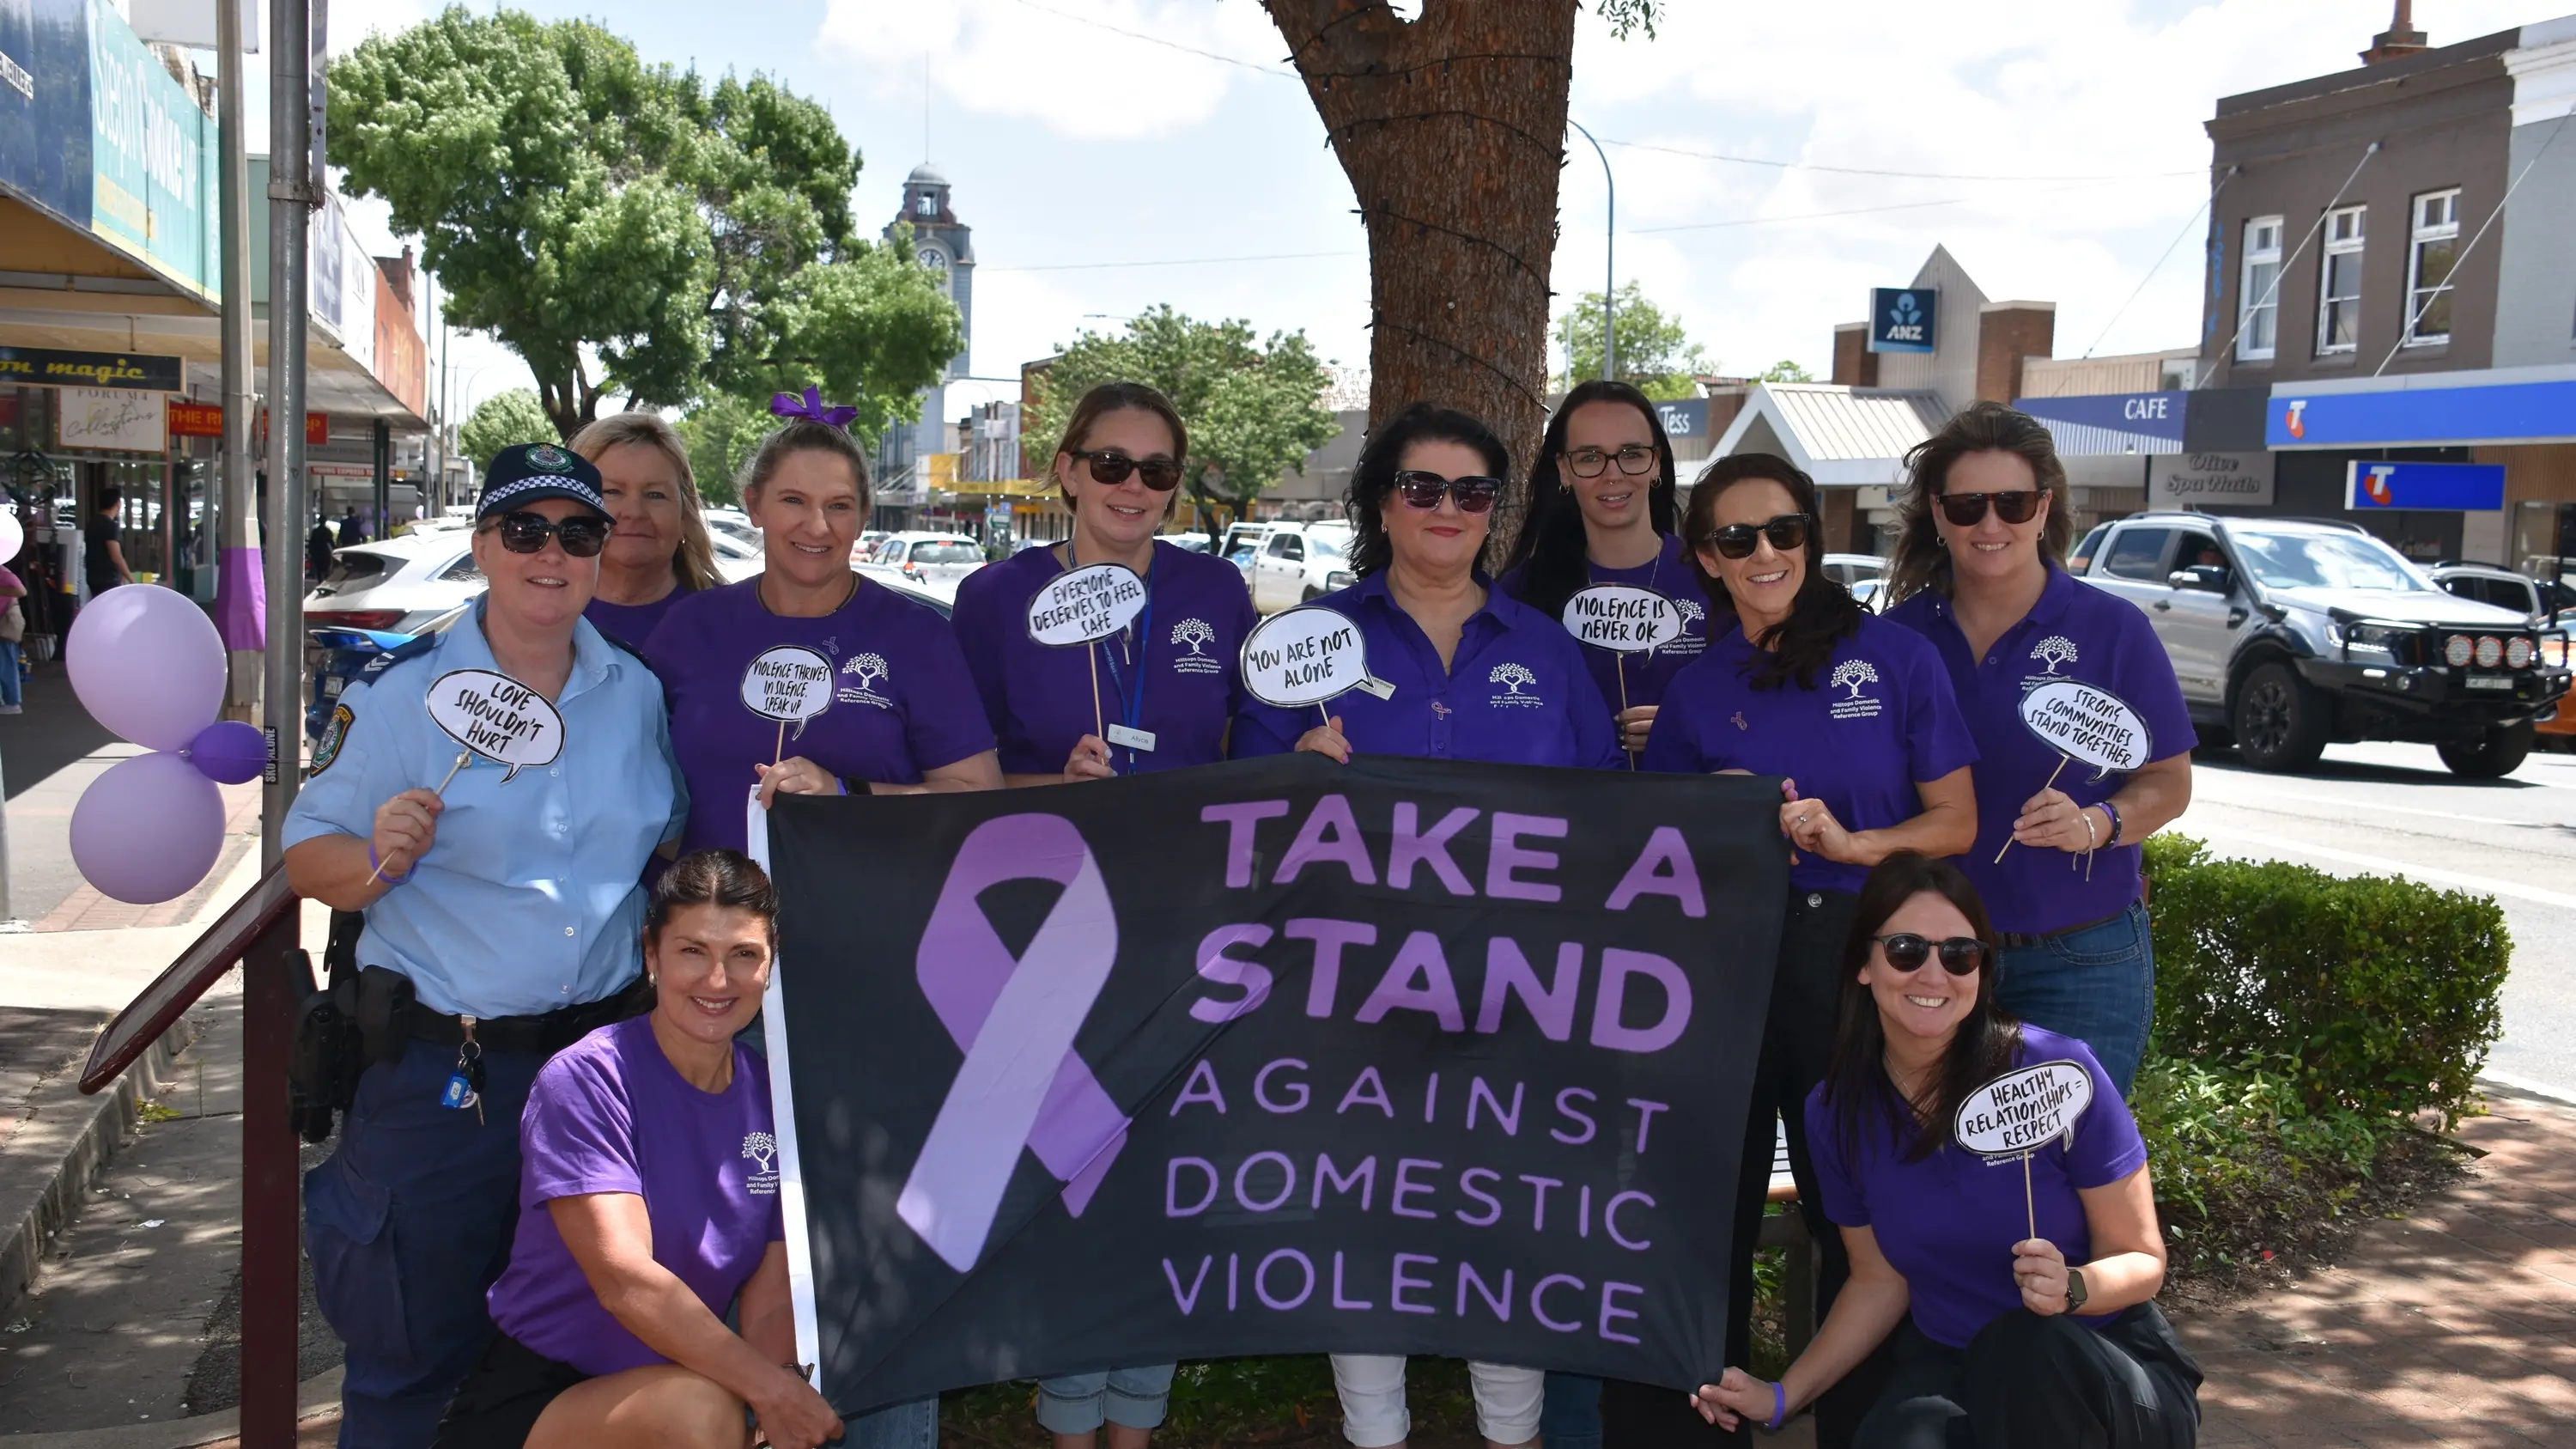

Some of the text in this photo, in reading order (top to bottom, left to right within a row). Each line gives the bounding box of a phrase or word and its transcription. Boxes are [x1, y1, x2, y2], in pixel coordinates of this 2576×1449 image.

[136, 59, 183, 202] Cooke
[1886, 325, 1923, 340] ANZ
[46, 358, 146, 384] magic
[168, 410, 201, 423] THE
[1659, 405, 1690, 434] Tess
[2124, 398, 2168, 420] CAFE
[2190, 454, 2239, 472] Olive
[2165, 474, 2260, 496] Spa Nails
[2370, 466, 2395, 496] T
[1053, 568, 1114, 605] EVERYONE
[1033, 581, 1141, 631] DESERVES TO FEEL
[1576, 596, 1665, 619] VIOLENCE IS
[1081, 611, 1112, 637] SAFE
[1582, 619, 1659, 642] NEVER OK
[1249, 628, 1352, 672] YOU ARE NOT
[754, 661, 829, 682] VIOLENCE THRIVES
[764, 681, 774, 694] IN
[1285, 656, 1333, 689] ALONE
[491, 682, 536, 710] LOVE
[764, 697, 802, 715] SPEAK UP
[2073, 689, 2124, 722] STRONG
[466, 719, 513, 753] HURT
[2045, 697, 2134, 746] COMMUNITIES
[2028, 709, 2132, 768] STAND TOGETHER
[1200, 793, 1707, 918] TAKE A
[1188, 916, 1693, 1054] STAND
[1990, 1068, 2055, 1107] HEALTHY
[1170, 1058, 1670, 1154] AGAINST
[1965, 1081, 2073, 1136] RELATIONSHIPS
[2002, 1109, 2061, 1148] RESPECT
[1986, 1156, 2015, 1167] Reference
[1164, 1150, 1656, 1251] DOMESTIC
[1162, 1247, 1644, 1345] VIOLENCE
